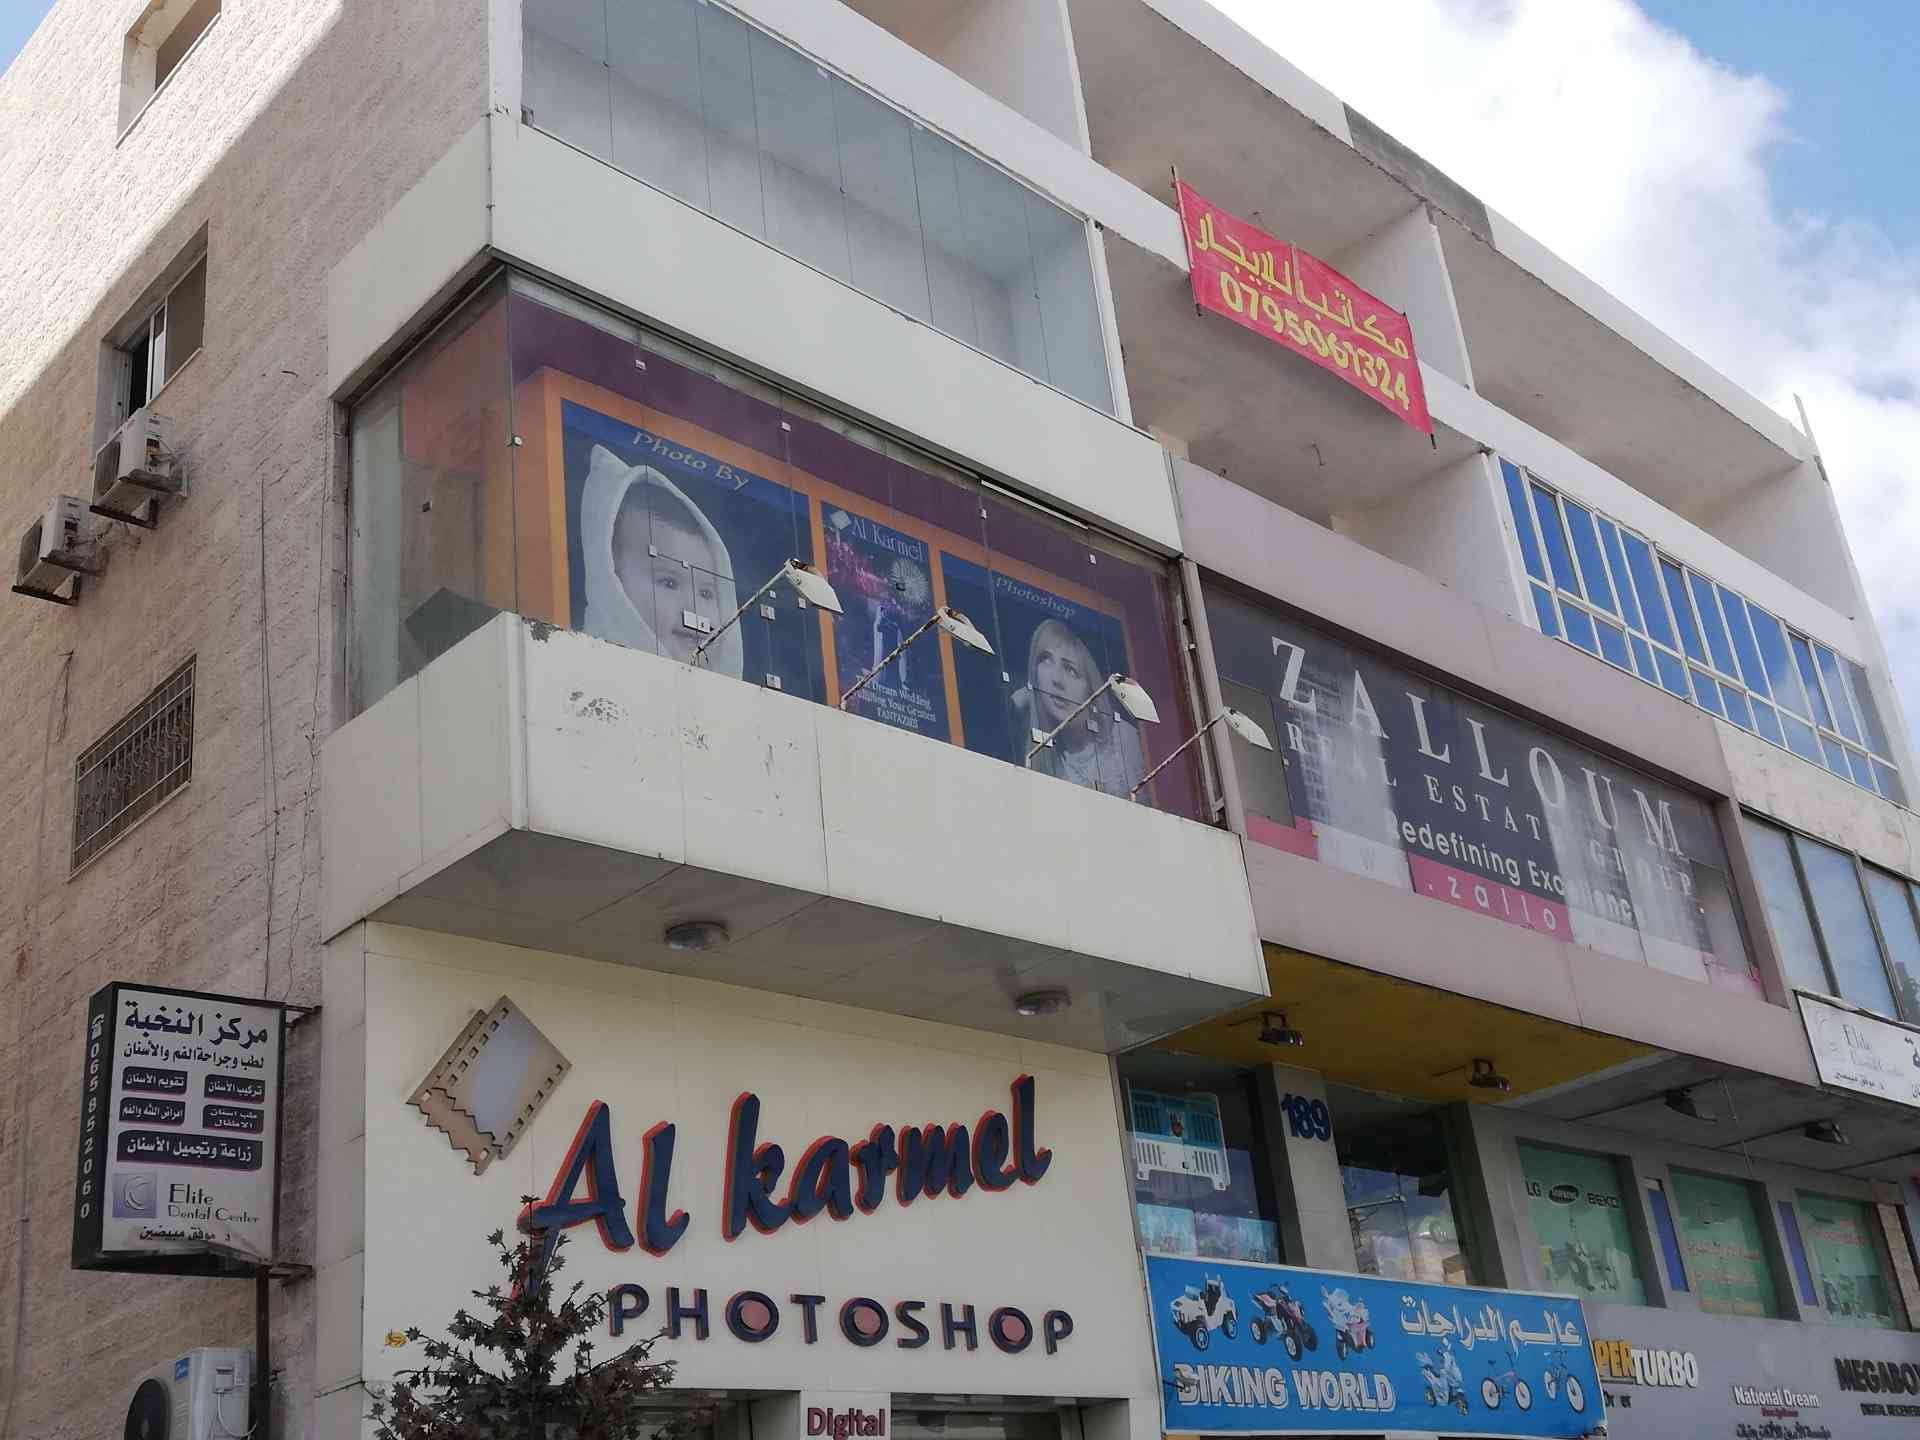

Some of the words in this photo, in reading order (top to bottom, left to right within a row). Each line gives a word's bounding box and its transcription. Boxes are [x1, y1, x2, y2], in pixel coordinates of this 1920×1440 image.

[632, 431, 707, 470] Photo
[715, 465, 750, 491] By
[995, 576, 1076, 620] Photoshop
[1271, 635, 1685, 858] ZALLOUM
[1423, 773, 1543, 841] ESTAT
[125, 1000, 203, 1038] النخبة
[209, 1012, 268, 1049] مركز
[1281, 1093, 1330, 1142] 189
[169, 1183, 214, 1205] Elite
[512, 1099, 690, 1300] Al
[721, 1073, 1053, 1243] karmel
[1525, 1180, 1541, 1197] LG
[167, 1204, 211, 1221] Dental
[215, 1207, 260, 1224] Center
[607, 1283, 1075, 1356] PHOTOSHOP
[1400, 1295, 1507, 1351] الدراجات
[1508, 1309, 1583, 1356] عالم
[1174, 1363, 1289, 1409] BIKING
[1292, 1369, 1396, 1413] WORLD
[1733, 1386, 1783, 1406] National
[1784, 1389, 1820, 1408] Dream
[807, 1407, 886, 1440] Digital
